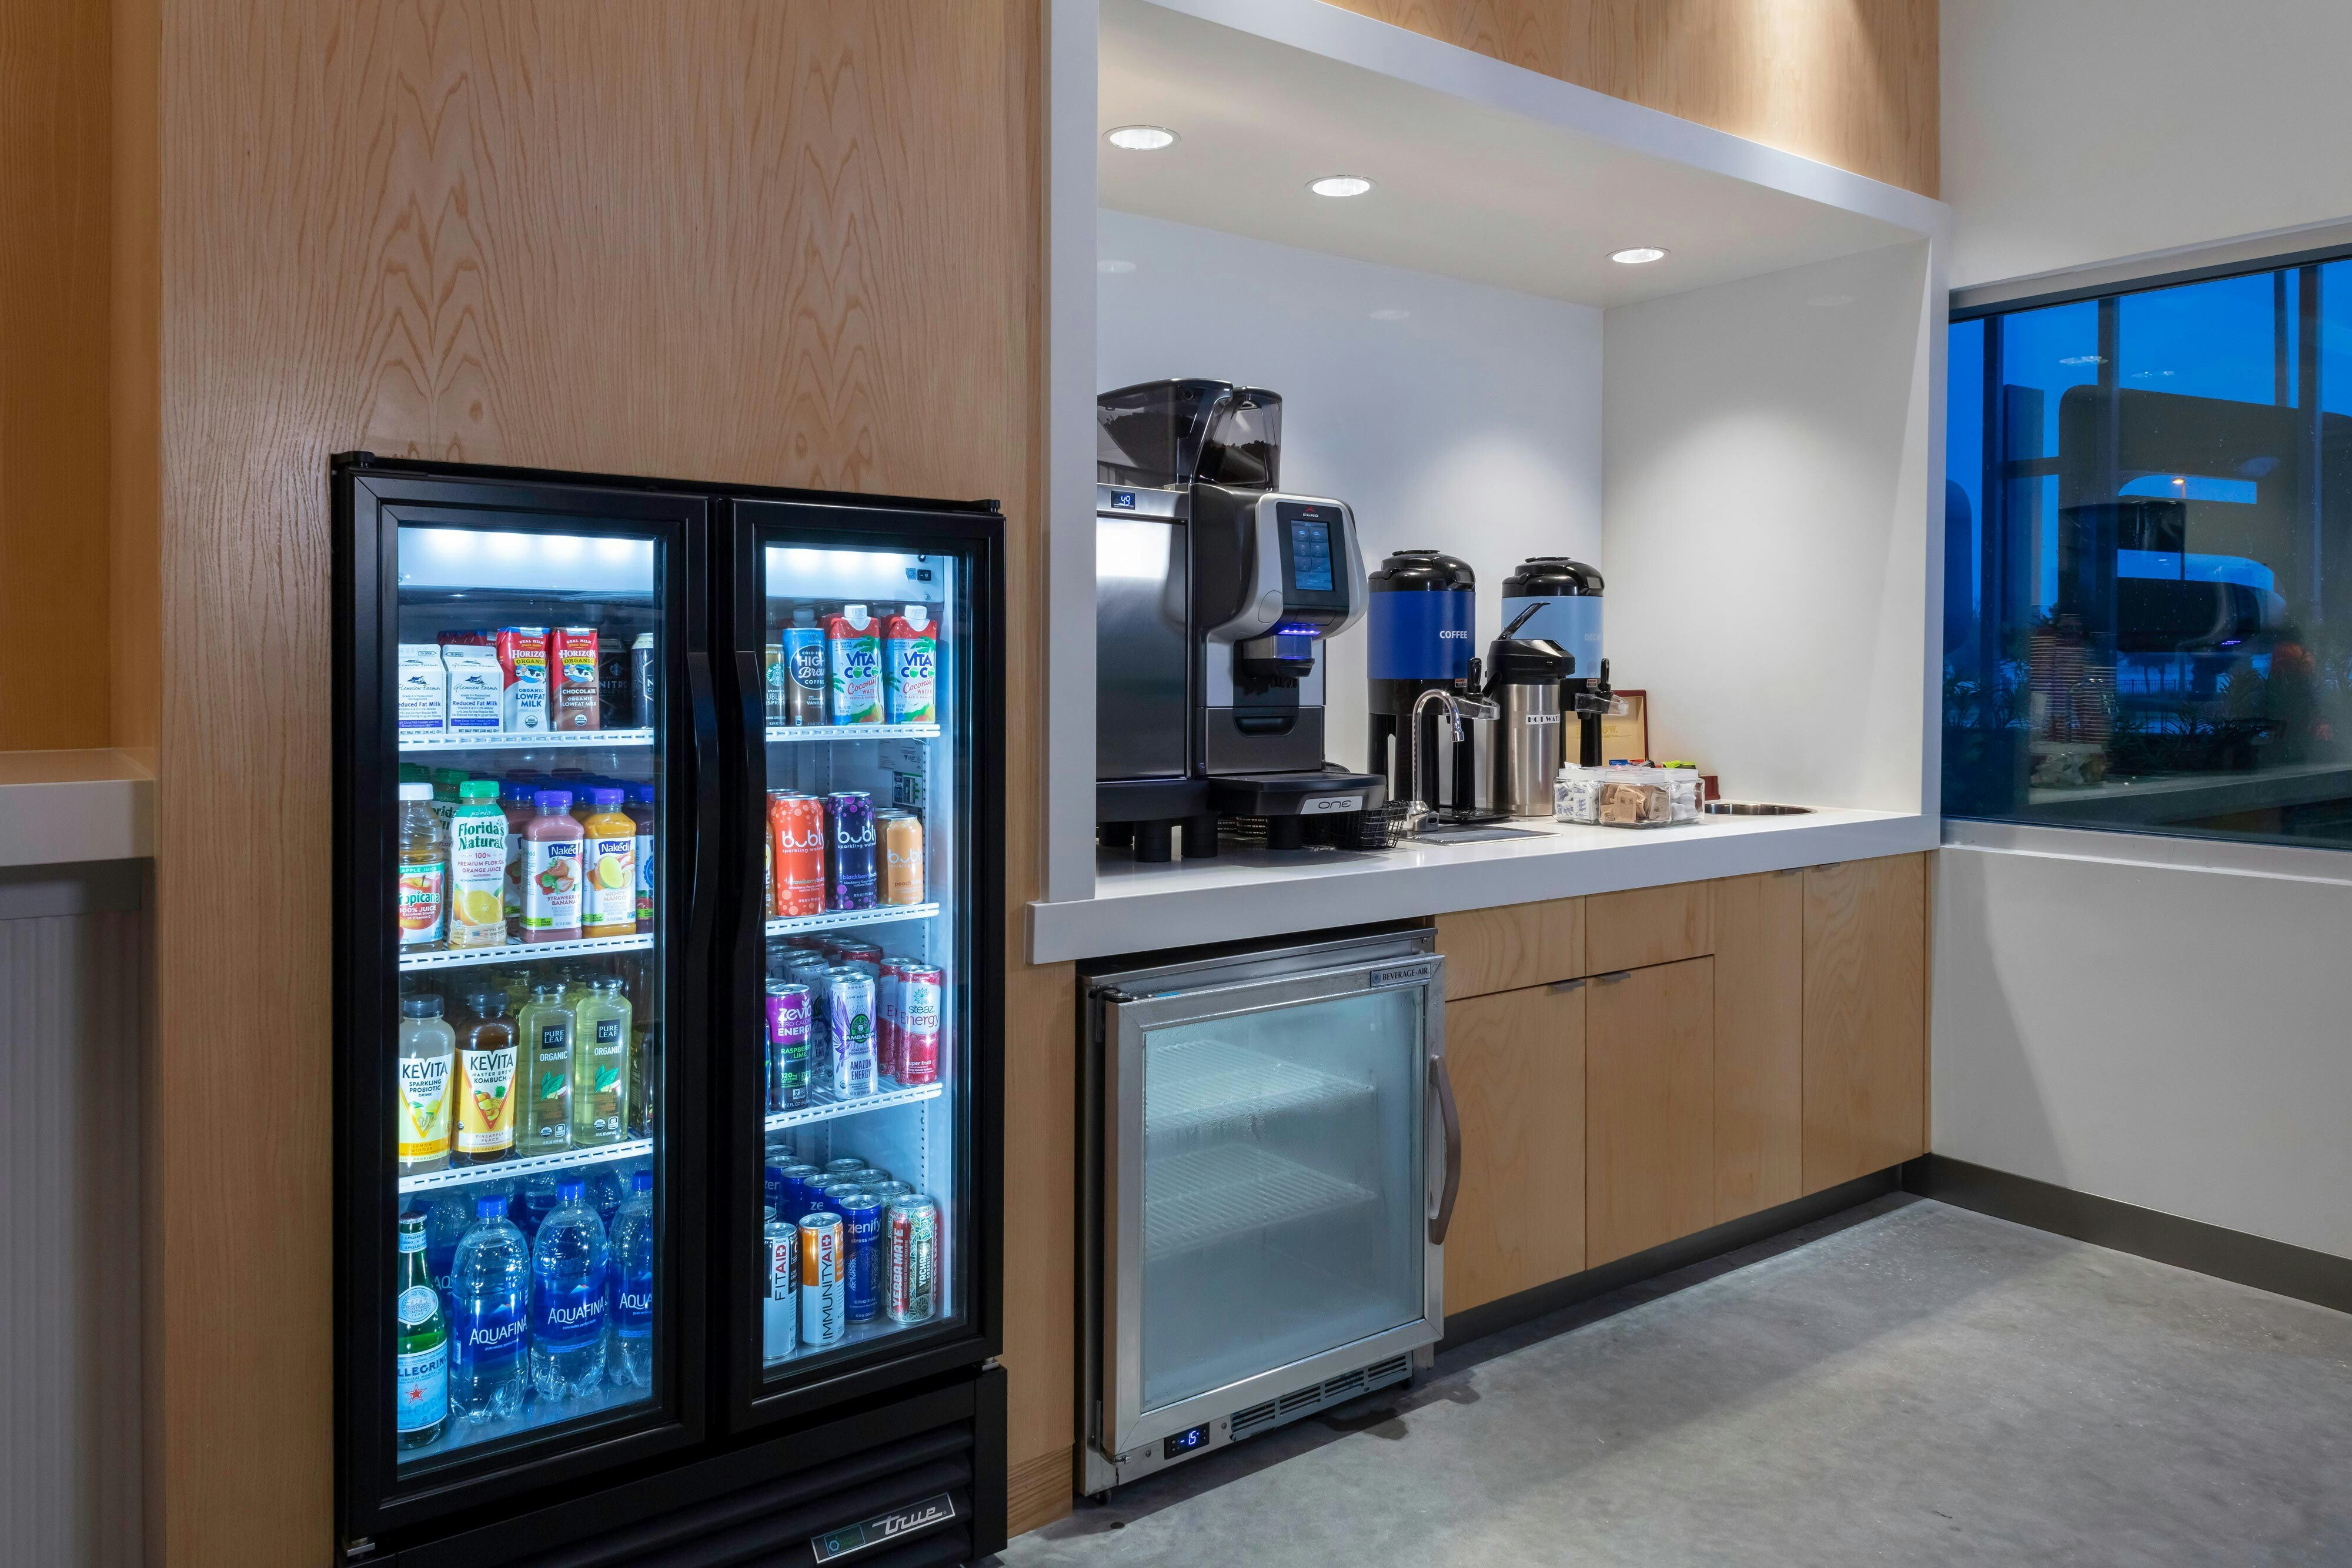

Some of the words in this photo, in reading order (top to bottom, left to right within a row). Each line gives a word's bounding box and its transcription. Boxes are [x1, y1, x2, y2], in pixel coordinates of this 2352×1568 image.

[1439, 631, 1468, 639] COFFEE
[512, 650, 546, 659] HORIZON
[560, 650, 596, 658] HORIZON
[846, 651, 876, 666] VITA
[904, 651, 933, 666] VITA
[799, 667, 825, 679] Brew
[844, 667, 879, 678] COCO
[901, 667, 935, 678] COCO
[453, 683, 480, 693] Glenview
[599, 681, 627, 689] NITRO
[847, 675, 877, 695] Coconut
[903, 676, 933, 694] Coconut
[782, 828, 824, 850] bubly
[837, 824, 876, 845] bubly
[458, 835, 505, 851] Natural
[551, 845, 577, 855] Naked
[602, 843, 628, 852] Naked
[887, 846, 923, 864] bubly
[399, 891, 440, 906] ropicana
[1382, 967, 1428, 981] BEVERAGE-AIR
[908, 1005, 934, 1014] steaz
[900, 1011, 940, 1028] Energy
[778, 1024, 811, 1037] ENERGY
[842, 1031, 875, 1040] SAMBAZON
[544, 1035, 564, 1044] LEAF
[594, 1046, 622, 1055] ORGANIC
[781, 1044, 811, 1054] RASPBERR
[540, 1051, 567, 1062] ORGANIC
[850, 1059, 871, 1070] AMAZON
[851, 1068, 871, 1080] ENERGY
[847, 1218, 881, 1233] zenify
[894, 1228, 903, 1264] MATE
[775, 1244, 786, 1300] FITAID
[822, 1234, 833, 1339] IMMUNITYAID
[893, 1266, 902, 1307] YERBA
[619, 1293, 652, 1310] AQUA
[548, 1296, 604, 1324] AQUAFINA
[469, 1314, 527, 1346] AQUAFINA
[398, 1353, 447, 1376] LLEGRINO
